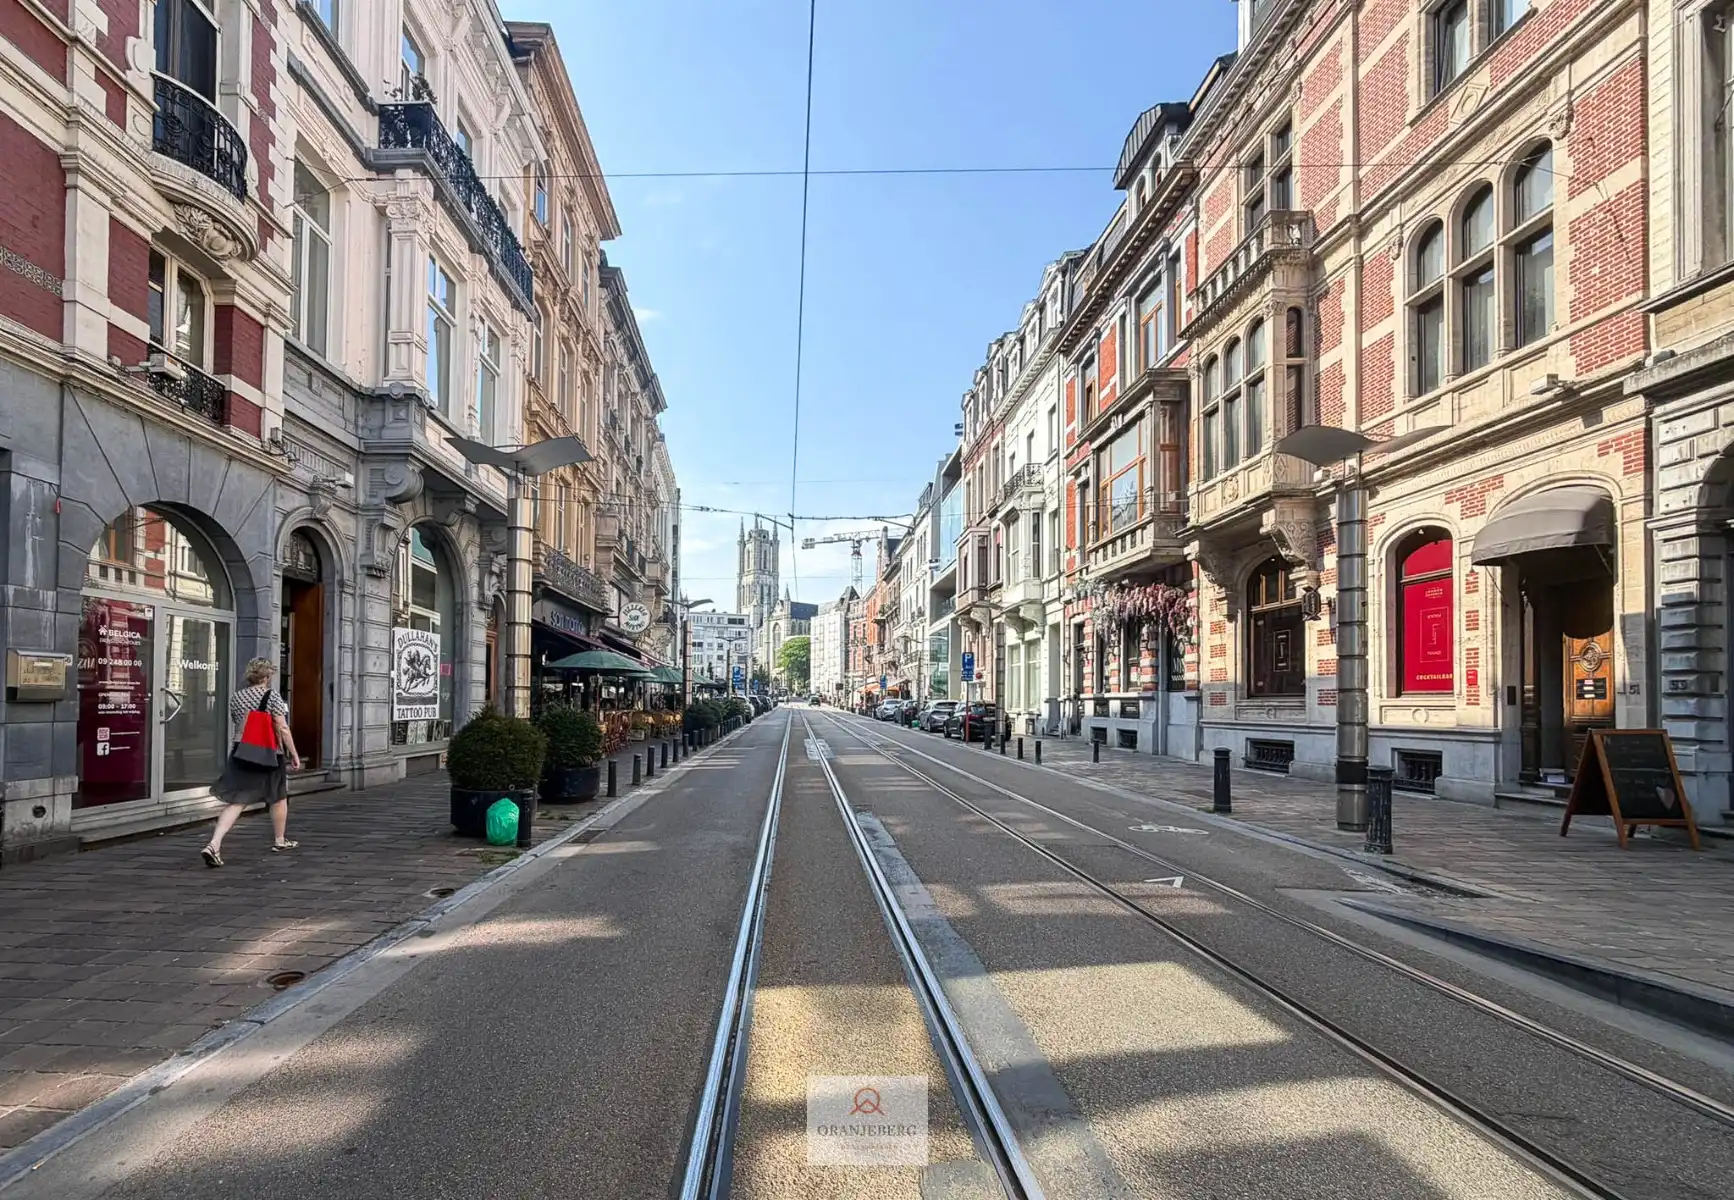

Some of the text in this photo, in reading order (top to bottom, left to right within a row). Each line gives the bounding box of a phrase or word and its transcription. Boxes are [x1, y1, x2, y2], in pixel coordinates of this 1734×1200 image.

[108, 629, 141, 639] BELGICA
[397, 630, 438, 652] DULLAHAN'S
[98, 657, 108, 665] 09
[177, 659, 219, 670] Welkom!
[397, 707, 437, 719] TATTOO PUB
